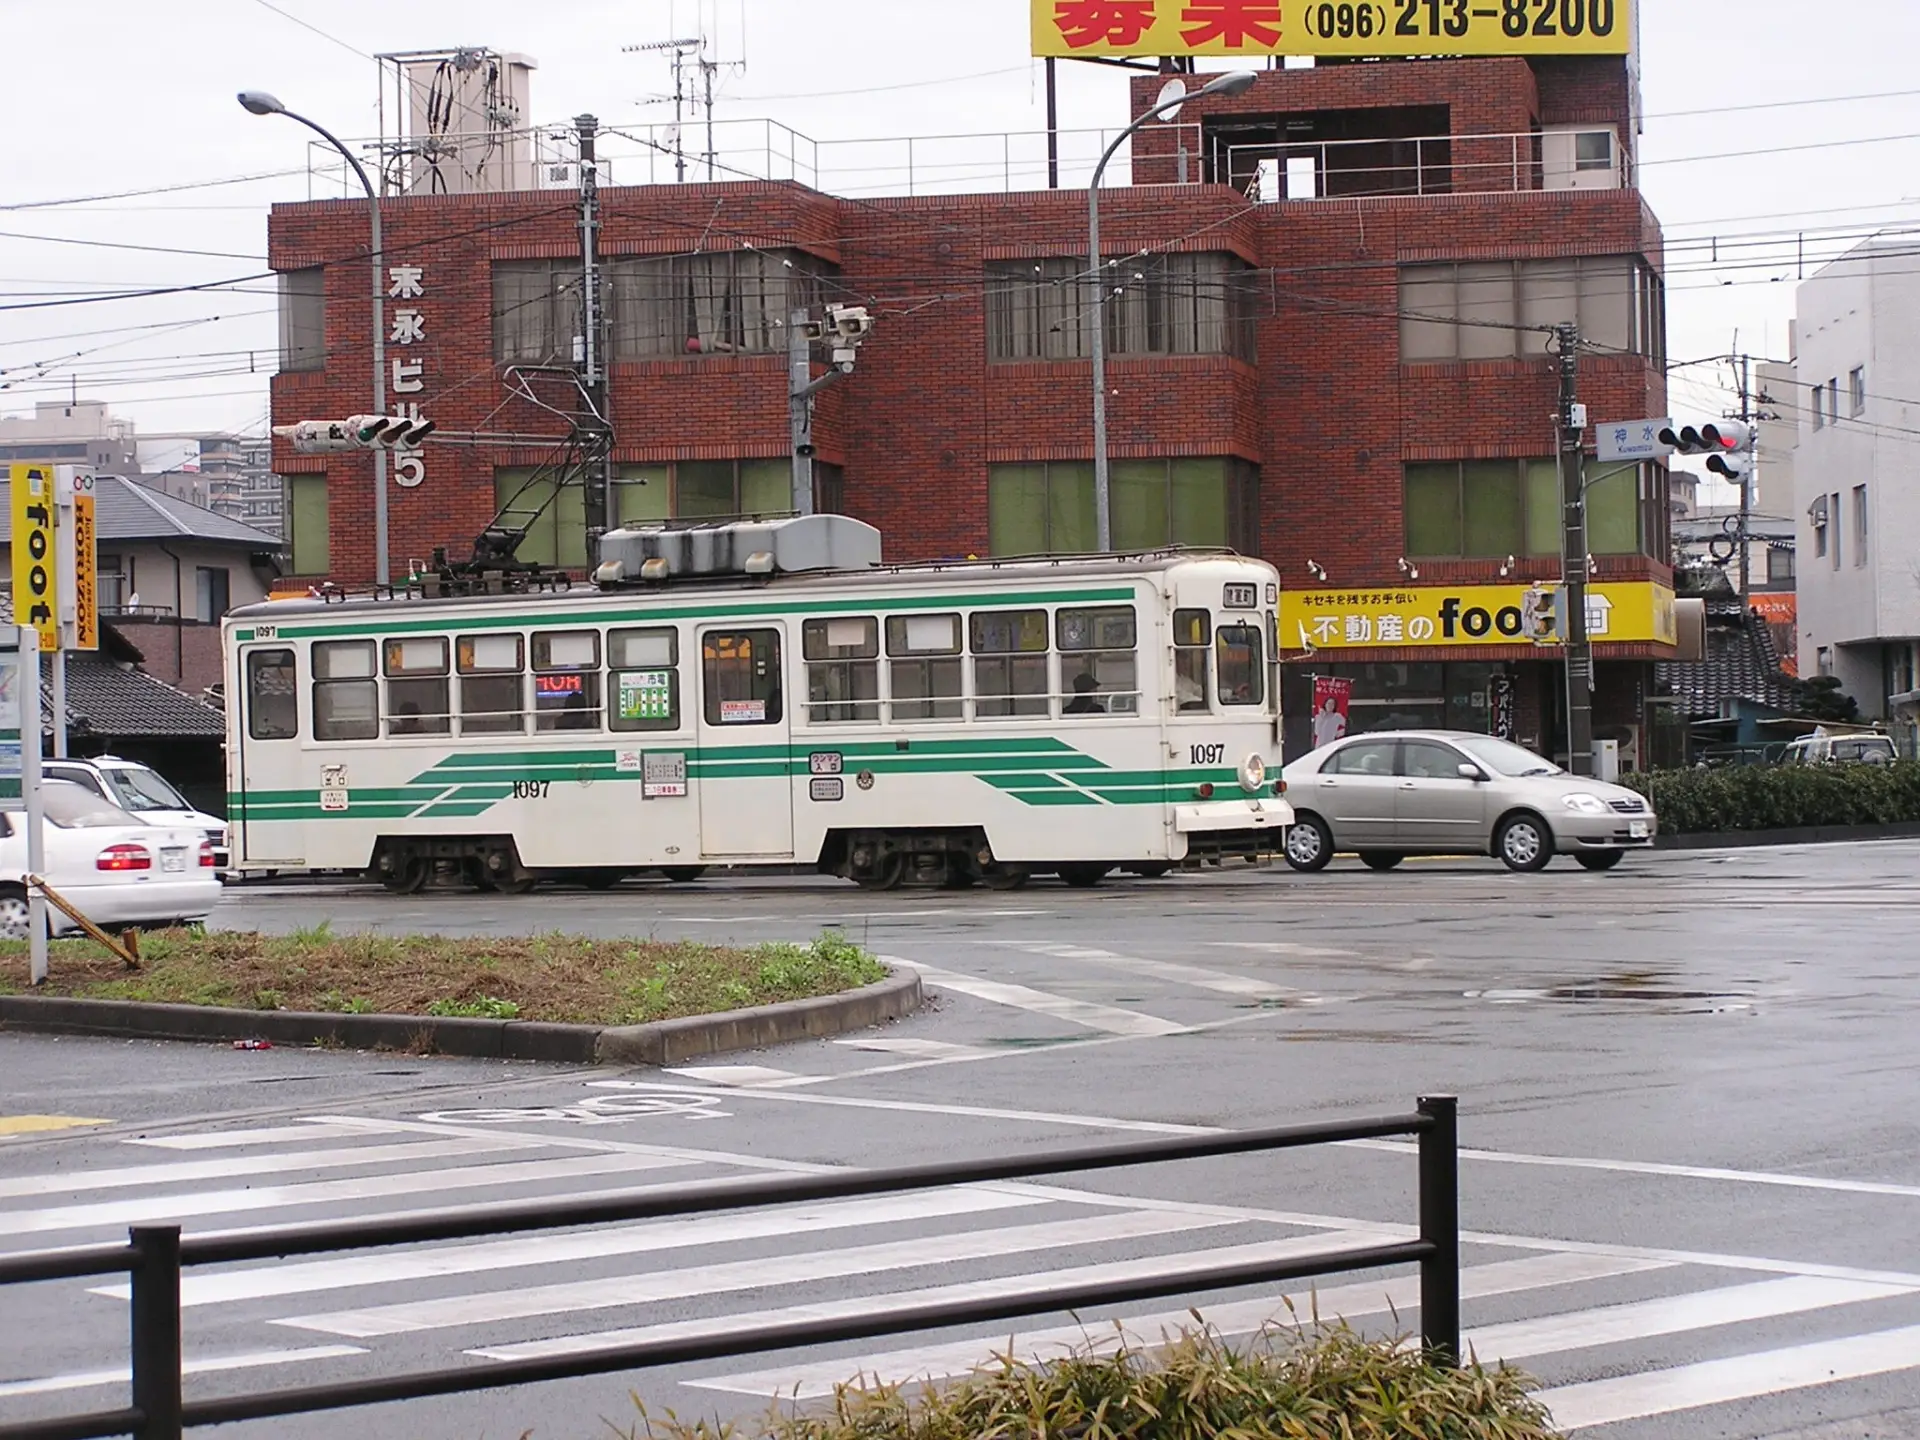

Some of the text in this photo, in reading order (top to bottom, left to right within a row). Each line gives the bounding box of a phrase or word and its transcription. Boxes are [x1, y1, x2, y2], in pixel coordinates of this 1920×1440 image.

[1614, 425, 1655, 443] 神水
[27, 502, 51, 624] foot
[1303, 593, 1418, 607] キセキを残すお手伝い
[1312, 598, 1523, 643] 不動産の foo
[256, 626, 275, 637] 1097
[1190, 744, 1225, 765] 1097
[513, 779, 550, 799] 1097
